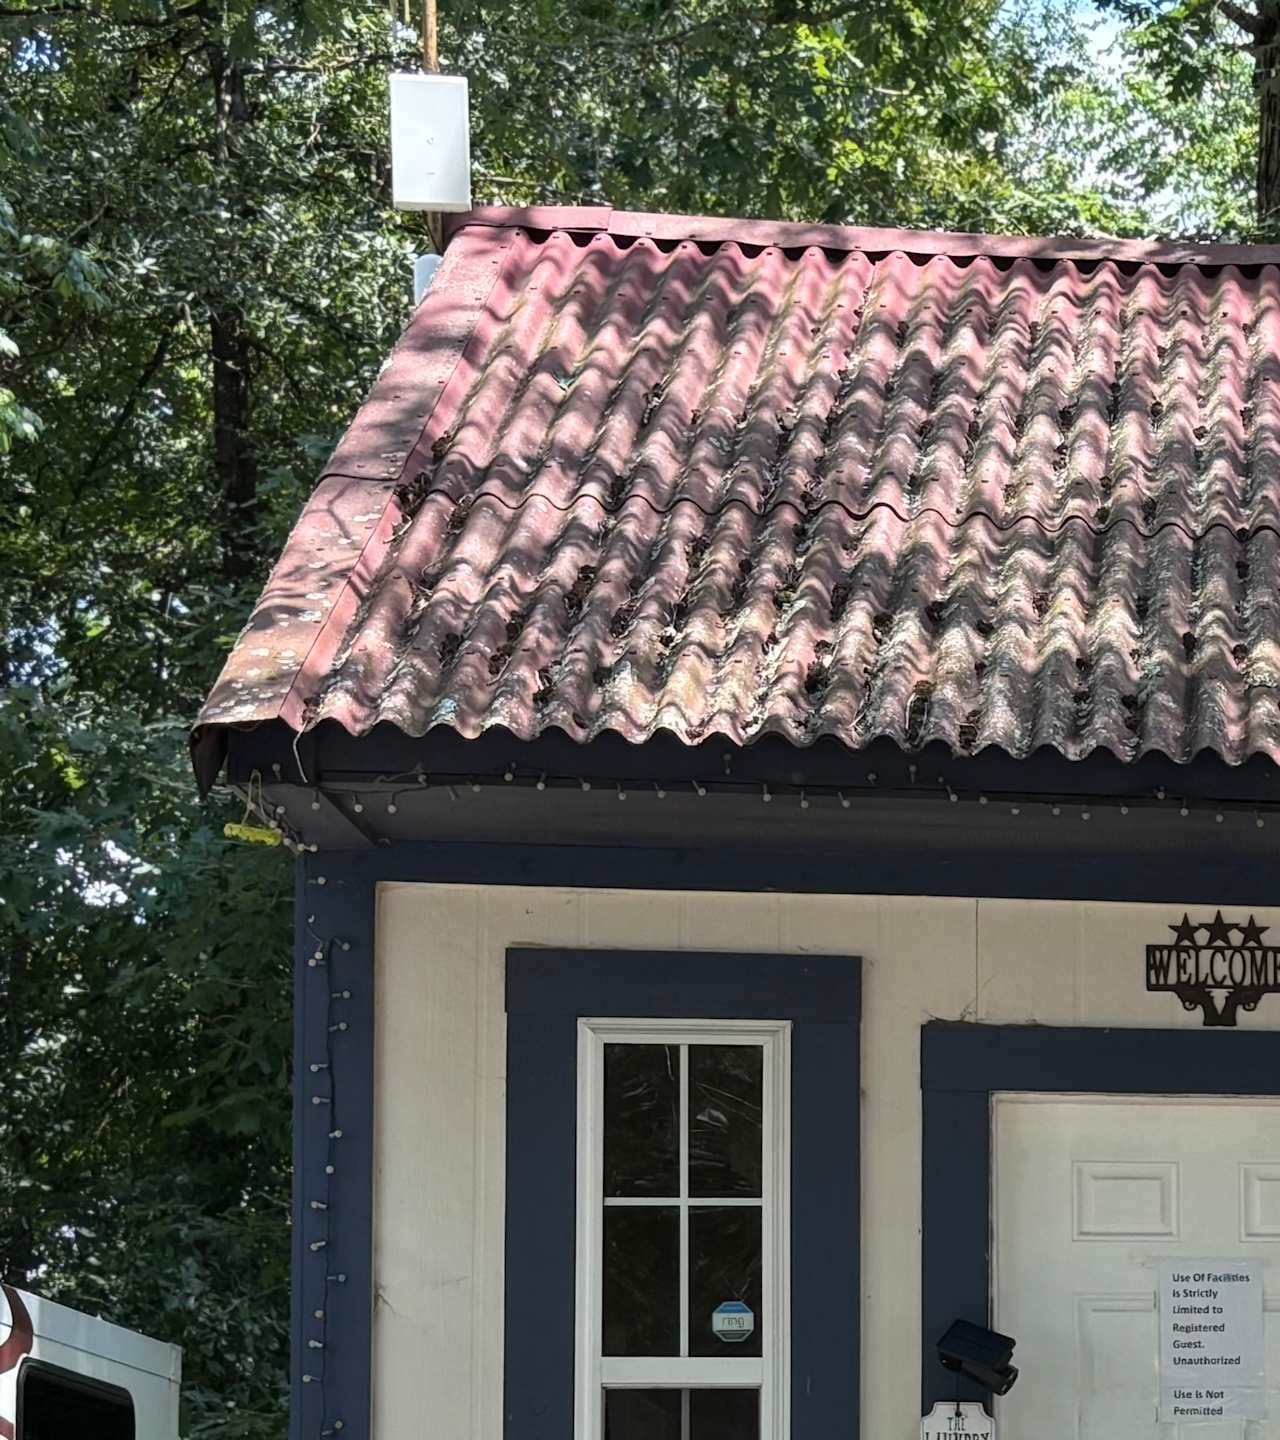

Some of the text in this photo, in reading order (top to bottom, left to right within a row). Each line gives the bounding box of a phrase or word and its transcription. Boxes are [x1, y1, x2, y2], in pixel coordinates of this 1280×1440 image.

[1172, 1272, 1250, 1282] Use Of Facilities
[1172, 1288, 1218, 1299] Is Strictly
[1172, 1305, 1223, 1314] Limited to
[1172, 1323, 1225, 1334] Registered
[1172, 1340, 1205, 1349] Guest.
[1173, 1356, 1241, 1365] Unauthorized
[1174, 1390, 1193, 1399] Use
[1206, 1389, 1225, 1399] Not
[1173, 1406, 1223, 1416] Permitted
[947, 1417, 966, 1431] THE
